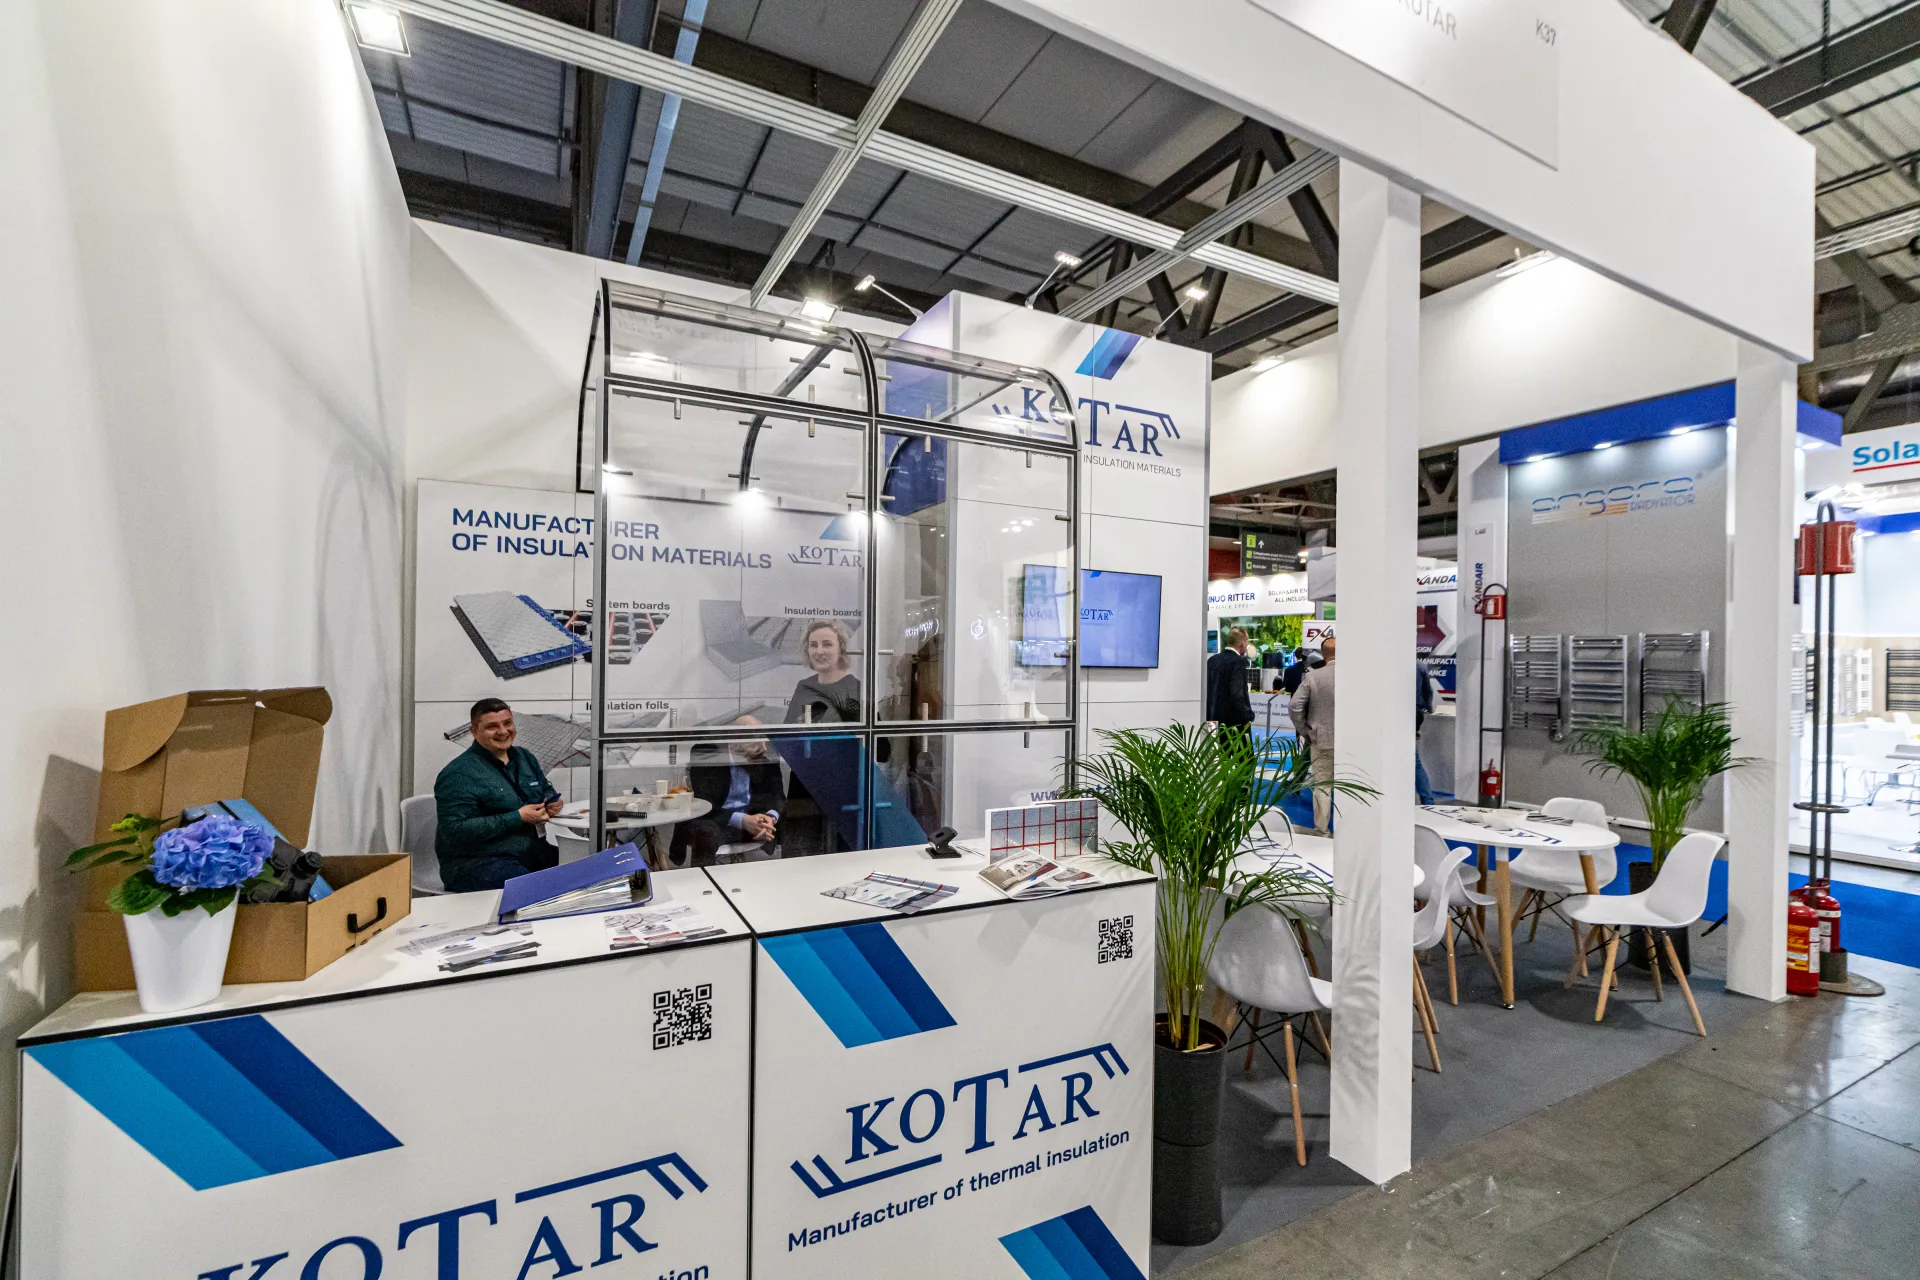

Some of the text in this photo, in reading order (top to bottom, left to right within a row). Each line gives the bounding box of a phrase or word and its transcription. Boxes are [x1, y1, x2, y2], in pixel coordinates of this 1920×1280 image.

[1536, 18, 1557, 46] K37
[1853, 440, 1920, 466] Sola
[1083, 454, 1182, 478] INSULATION MATERIALS
[452, 507, 659, 540] MANUFACTRER
[452, 532, 772, 570] OF INSULAON MATERIALS
[799, 545, 862, 568] KOTAR
[586, 599, 671, 611] Stem boards
[1227, 592, 1256, 602] RITTER
[784, 606, 863, 617] Insulation boards
[645, 701, 669, 711] foils
[845, 1069, 1100, 1165] KOTAR
[788, 1131, 1130, 1252] Manufacturer of thermal insulation
